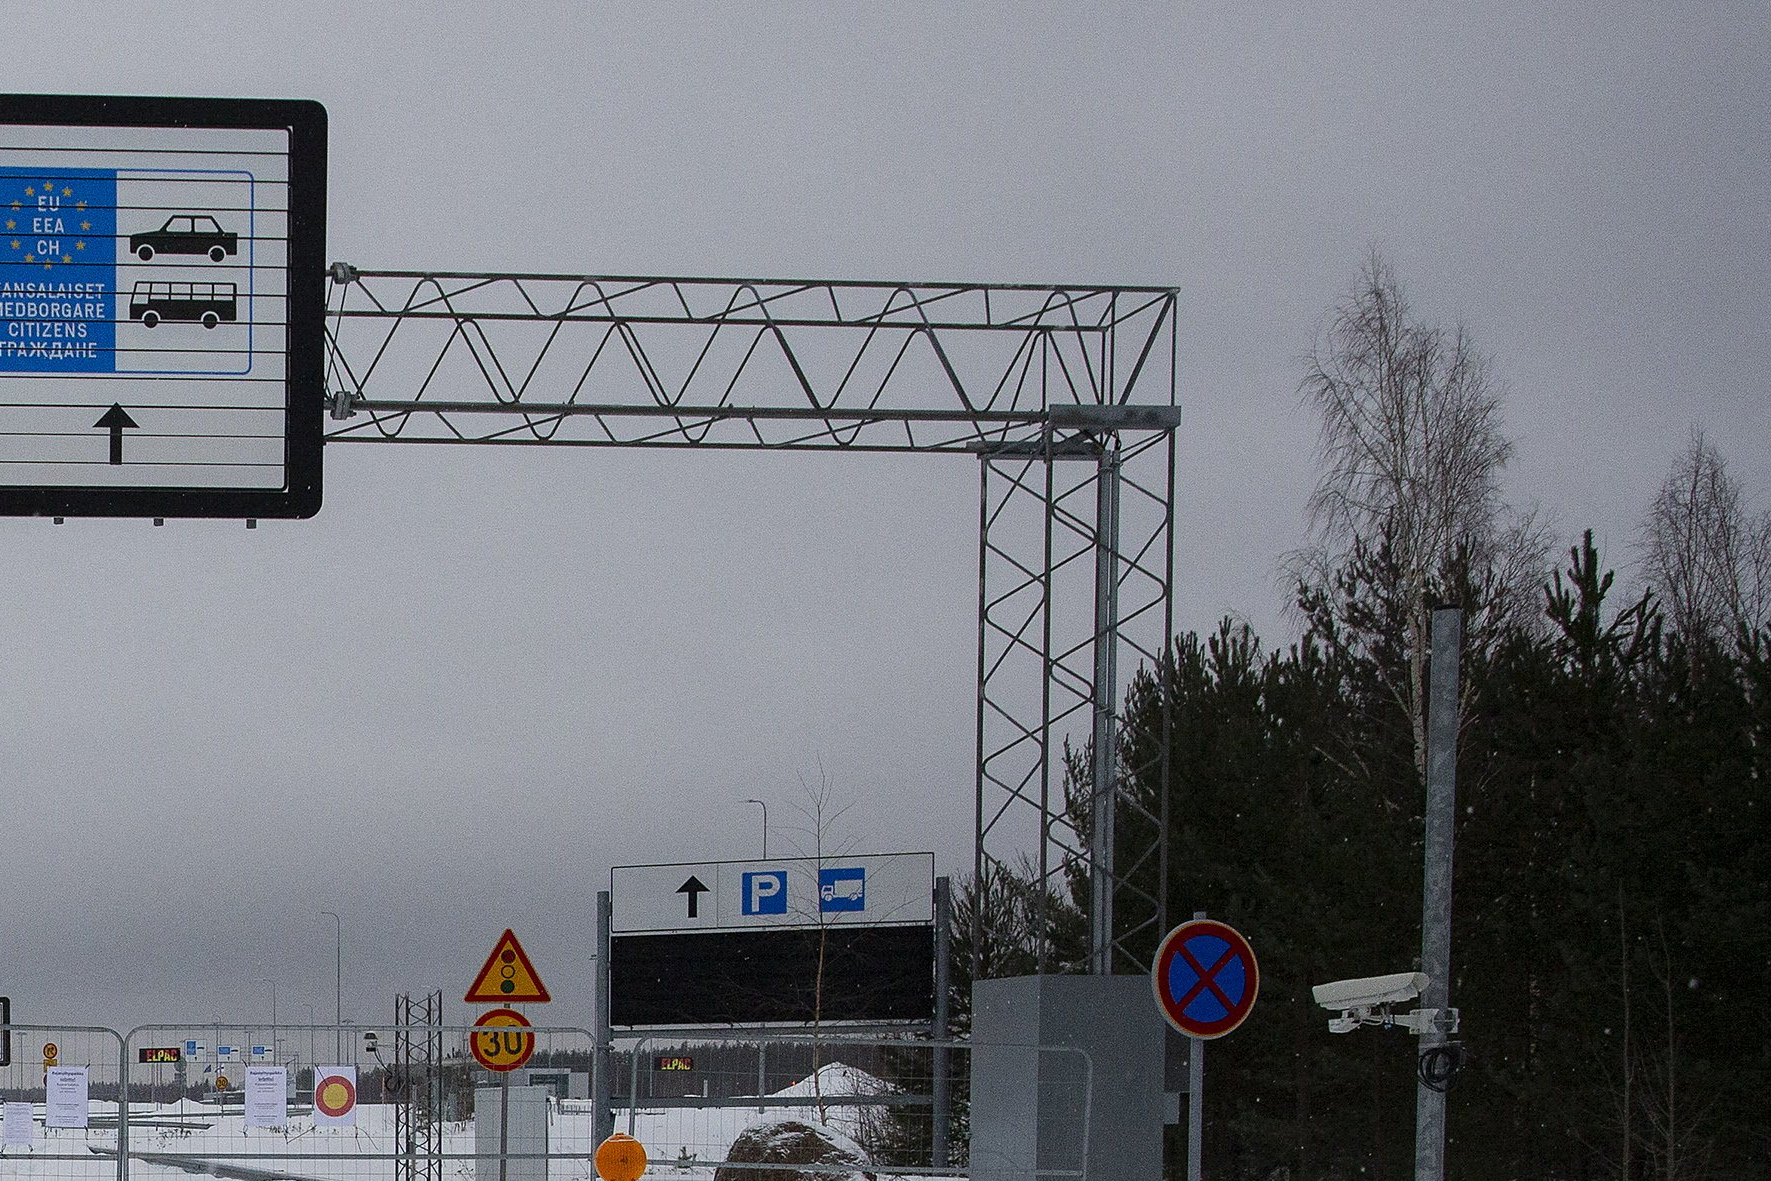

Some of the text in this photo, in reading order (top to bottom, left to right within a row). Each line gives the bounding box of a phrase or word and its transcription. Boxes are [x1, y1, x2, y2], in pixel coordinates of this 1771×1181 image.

[37, 194, 61, 213] EU
[33, 217, 65, 234] EEA
[36, 240, 60, 256] CH
[8, 321, 88, 338] CITIZENS
[751, 874, 781, 912] P
[482, 1024, 523, 1056] 30
[146, 1049, 178, 1062] ELPAC
[660, 1057, 692, 1071] ELPAC
